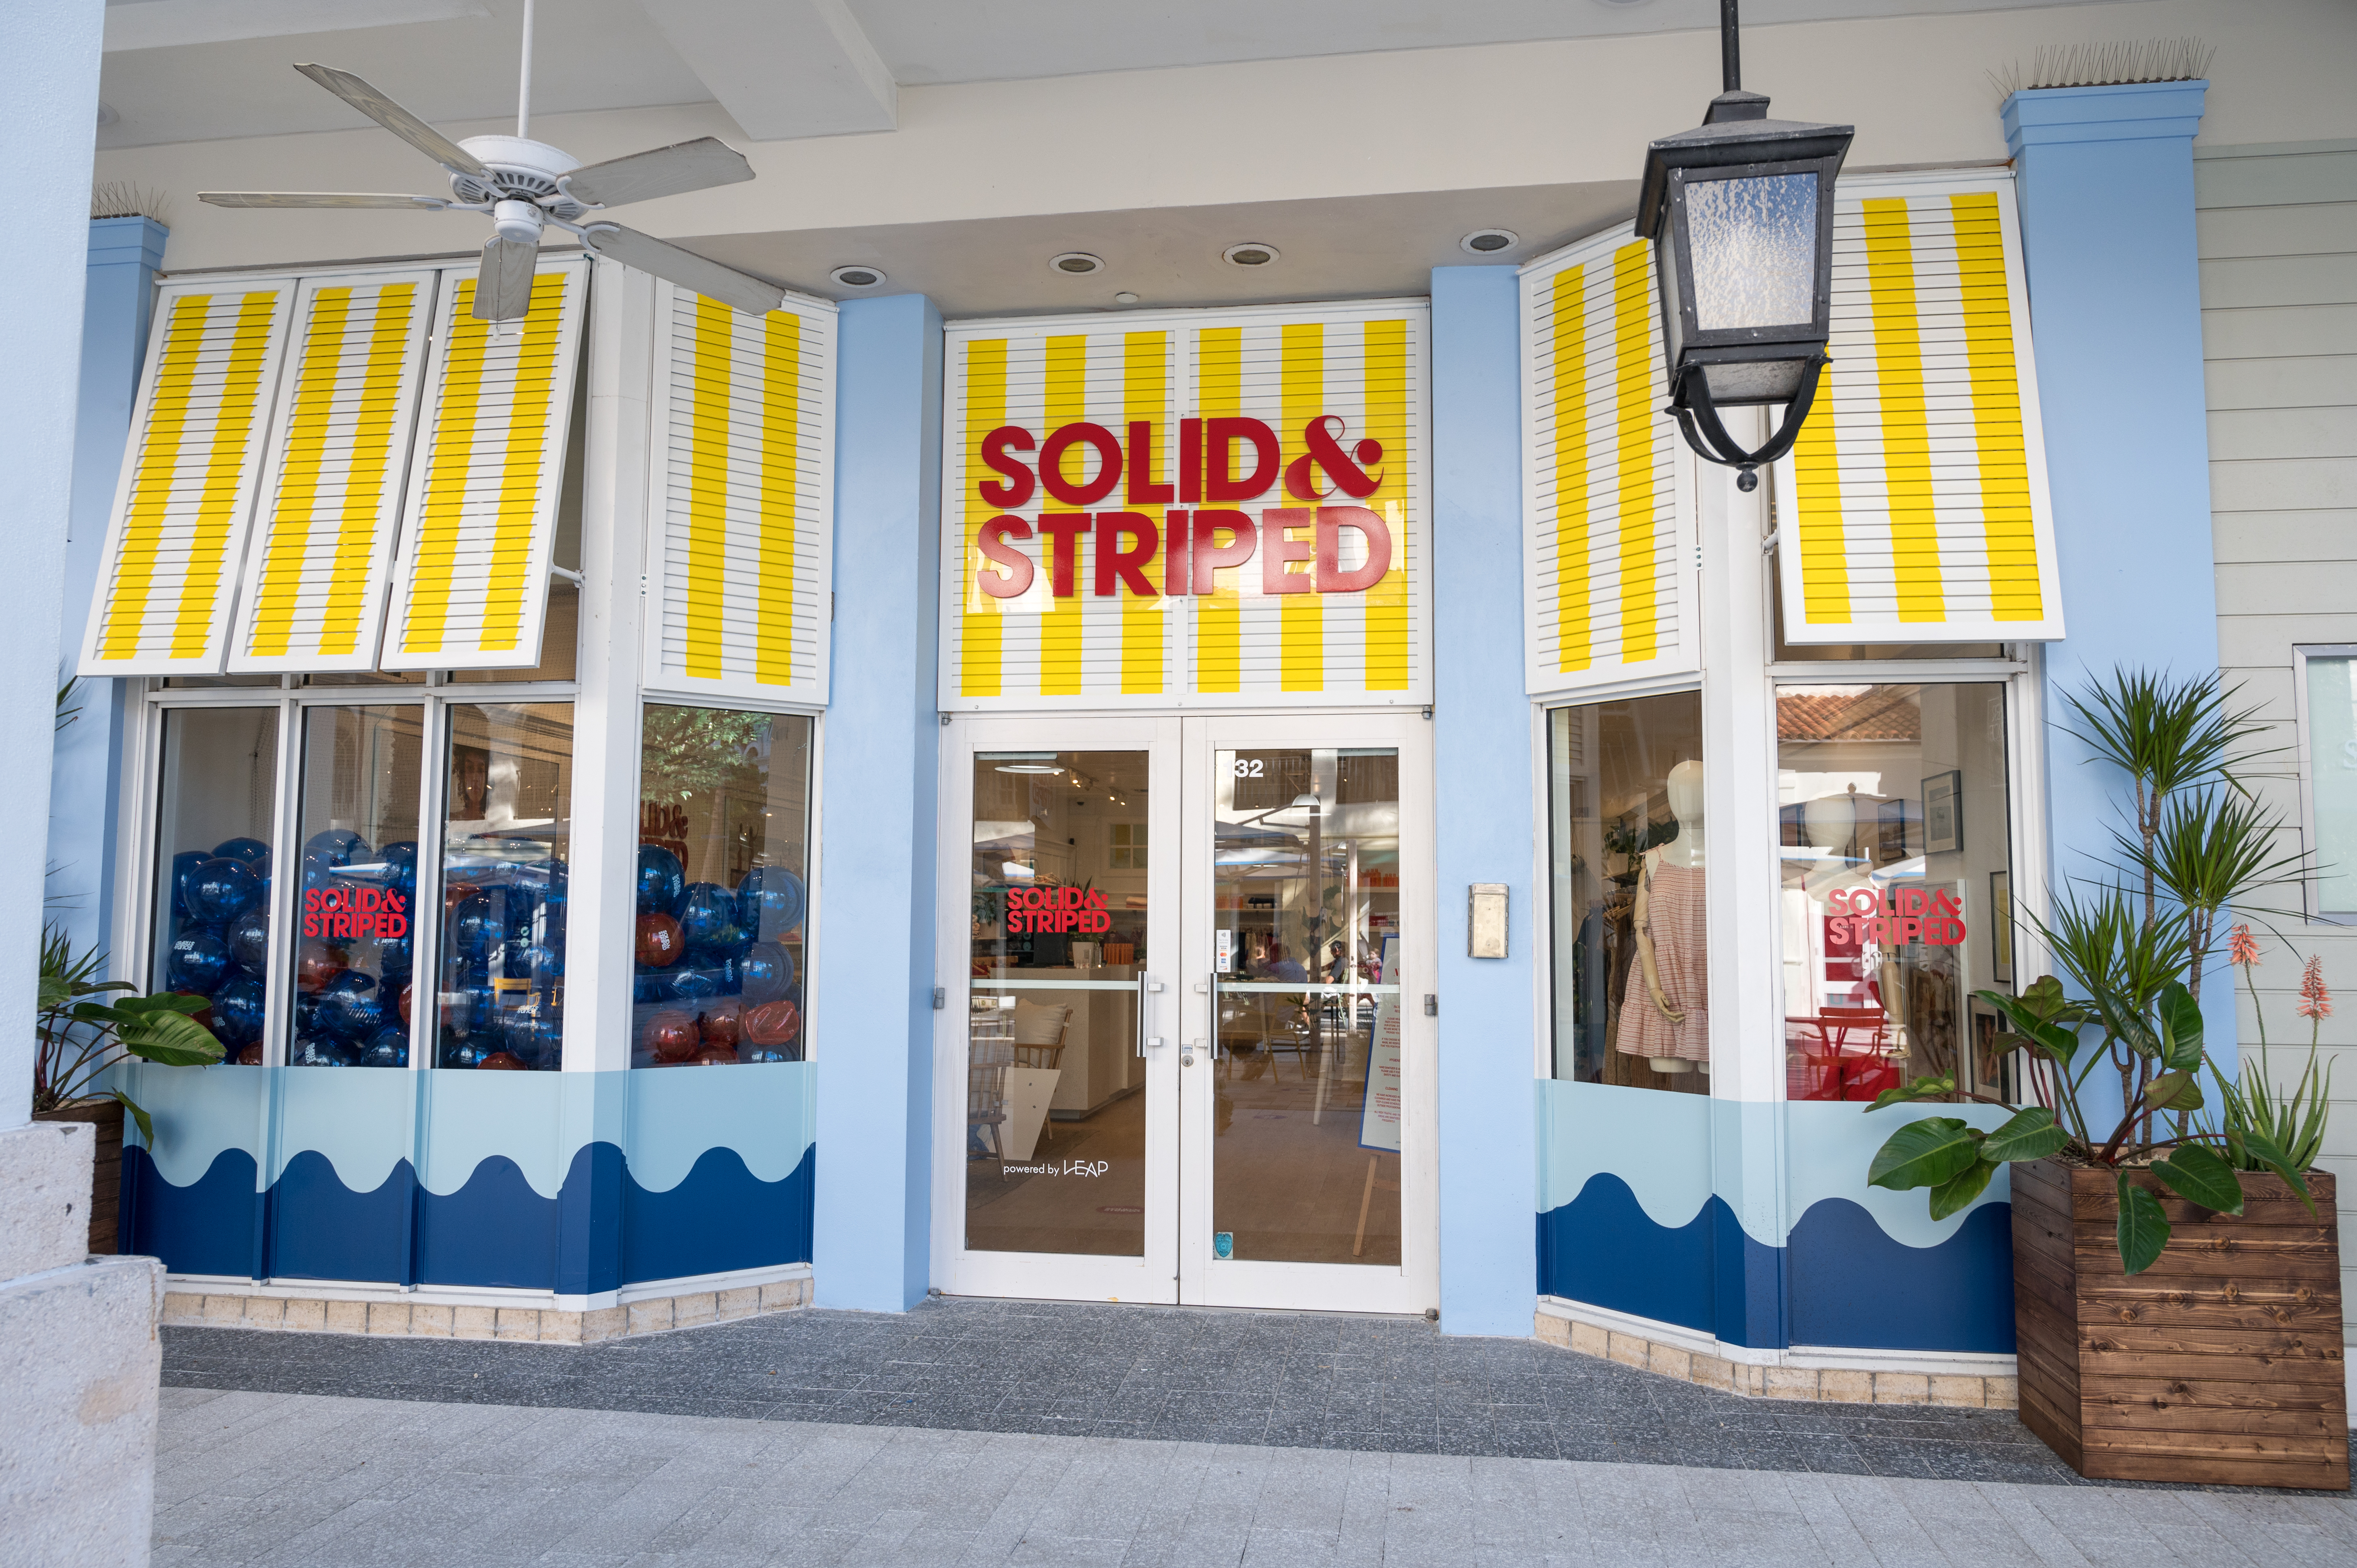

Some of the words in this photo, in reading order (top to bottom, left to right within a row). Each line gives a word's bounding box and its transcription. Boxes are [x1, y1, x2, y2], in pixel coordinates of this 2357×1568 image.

[977, 506, 1392, 598] STRIPED
[1223, 759, 1264, 778] 132
[304, 913, 407, 937] STRIPED
[1008, 910, 1111, 933] STRIPED
[1829, 917, 1966, 946] STRIPED
[1004, 1164, 1045, 1175] powered
[1048, 1164, 1059, 1177] by
[1064, 1160, 1108, 1177] LEAP
